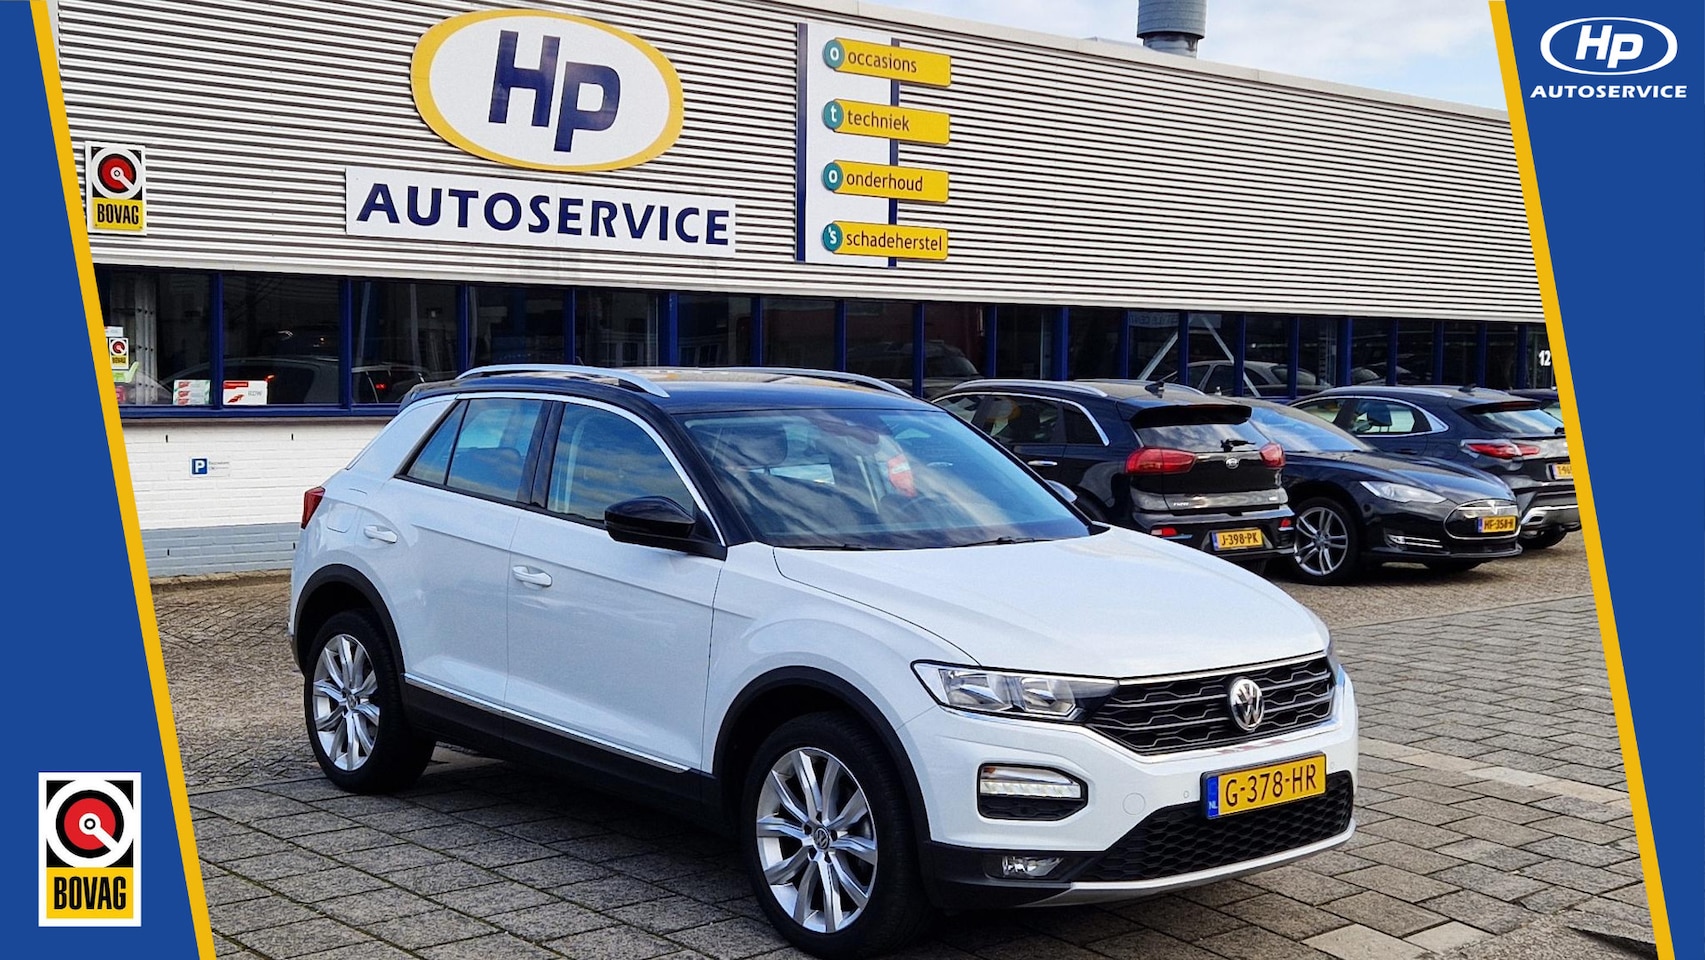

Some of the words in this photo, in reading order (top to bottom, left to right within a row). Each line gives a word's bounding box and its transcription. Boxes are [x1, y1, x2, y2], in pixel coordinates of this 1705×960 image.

[847, 51, 918, 74] occasions
[847, 110, 910, 132] techniek
[846, 171, 924, 192] onderhoud
[97, 203, 140, 225] BOVAG
[356, 182, 730, 246] AUTOSERVICE
[846, 231, 943, 252] schadeherstel
[1221, 531, 1259, 546] J-398-PK
[1225, 763, 1317, 808] G-378-HR
